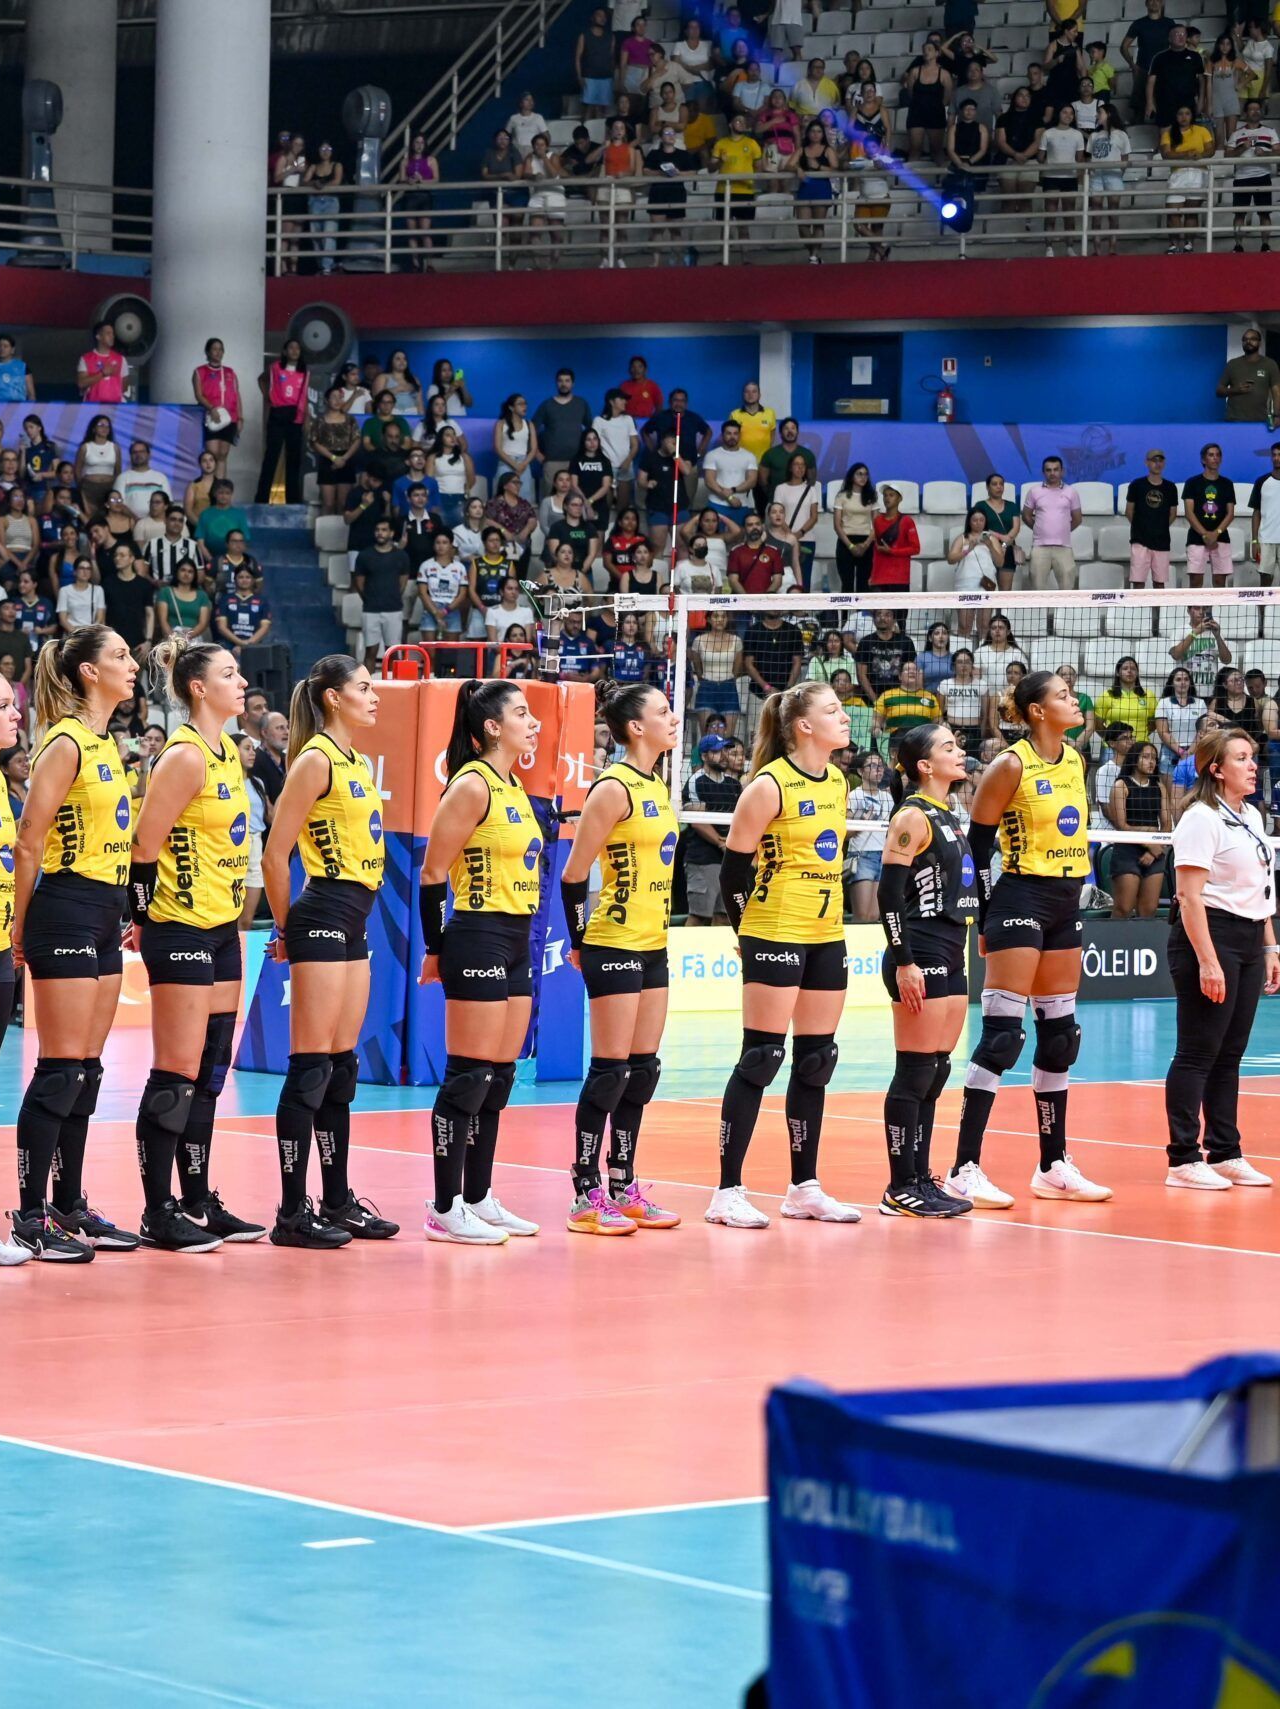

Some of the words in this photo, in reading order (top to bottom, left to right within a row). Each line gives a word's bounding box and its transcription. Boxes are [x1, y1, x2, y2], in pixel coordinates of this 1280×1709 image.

[32, 456, 41, 471] 9
[578, 462, 603, 471] VANS
[231, 824, 246, 834] NIVEA
[1058, 817, 1078, 826] NIVEA
[56, 804, 78, 874] entil
[661, 844, 675, 853] NIVEA
[816, 842, 837, 850] NIVEA
[168, 826, 194, 910] Dentil
[483, 847, 491, 873] sorriu.
[629, 841, 637, 867] sorriu.
[484, 875, 492, 898] Usou,
[606, 842, 630, 925] Dentil
[630, 870, 639, 893] Usou,
[979, 869, 990, 901] Dentil
[134, 883, 147, 912] Dentil
[818, 889, 831, 918] 7
[576, 903, 585, 932] Dentil
[886, 912, 902, 946] Dentil
[682, 954, 706, 979] Fã
[712, 955, 738, 977] do
[846, 951, 884, 976] rasil
[755, 951, 800, 963] crock's
[1133, 949, 1157, 976] ID
[1040, 1100, 1052, 1135] Dentil
[318, 1130, 331, 1166] Dentil
[435, 1114, 448, 1157] Dentil
[579, 1132, 594, 1165] Dentil
[617, 1130, 628, 1161] Dentil
[791, 1118, 802, 1152] Dentil
[890, 1124, 903, 1156] Dentil
[188, 1143, 201, 1175] Dentil
[283, 1140, 294, 1173] Dentil
